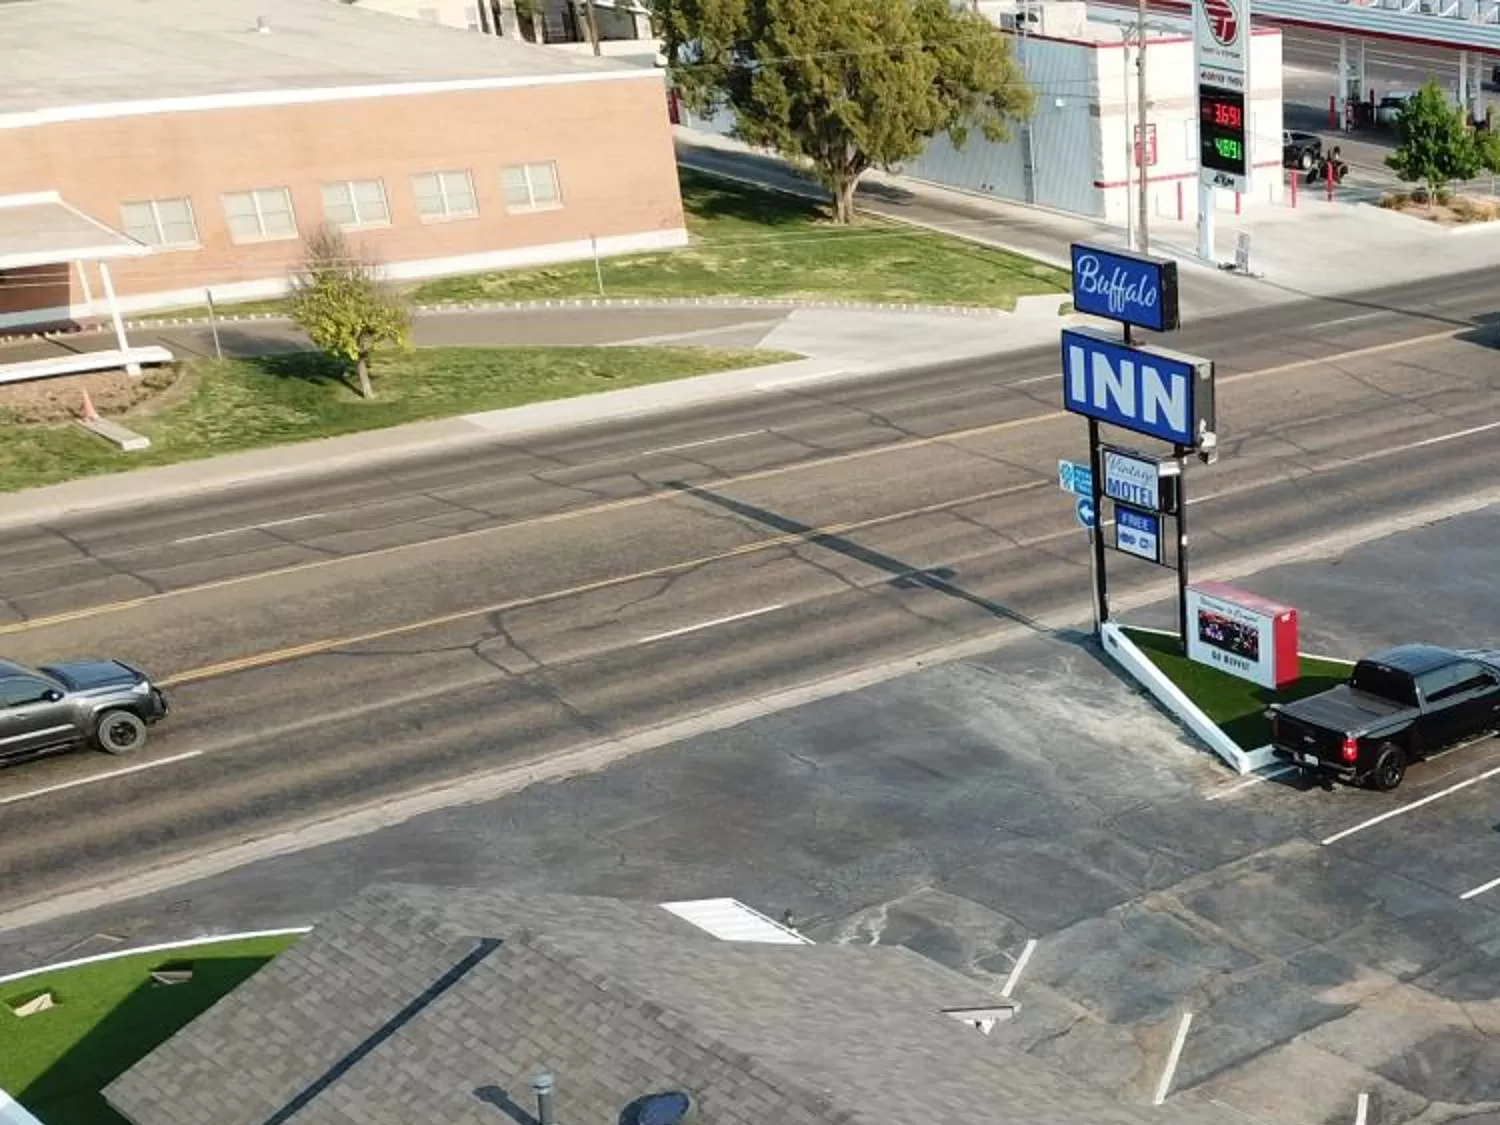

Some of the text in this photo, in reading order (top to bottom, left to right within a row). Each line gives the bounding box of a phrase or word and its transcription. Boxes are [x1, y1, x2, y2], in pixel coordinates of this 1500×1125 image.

[1077, 255, 1157, 313] Buffalo
[1069, 345, 1186, 433] INN
[1107, 477, 1153, 507] MOTEL
